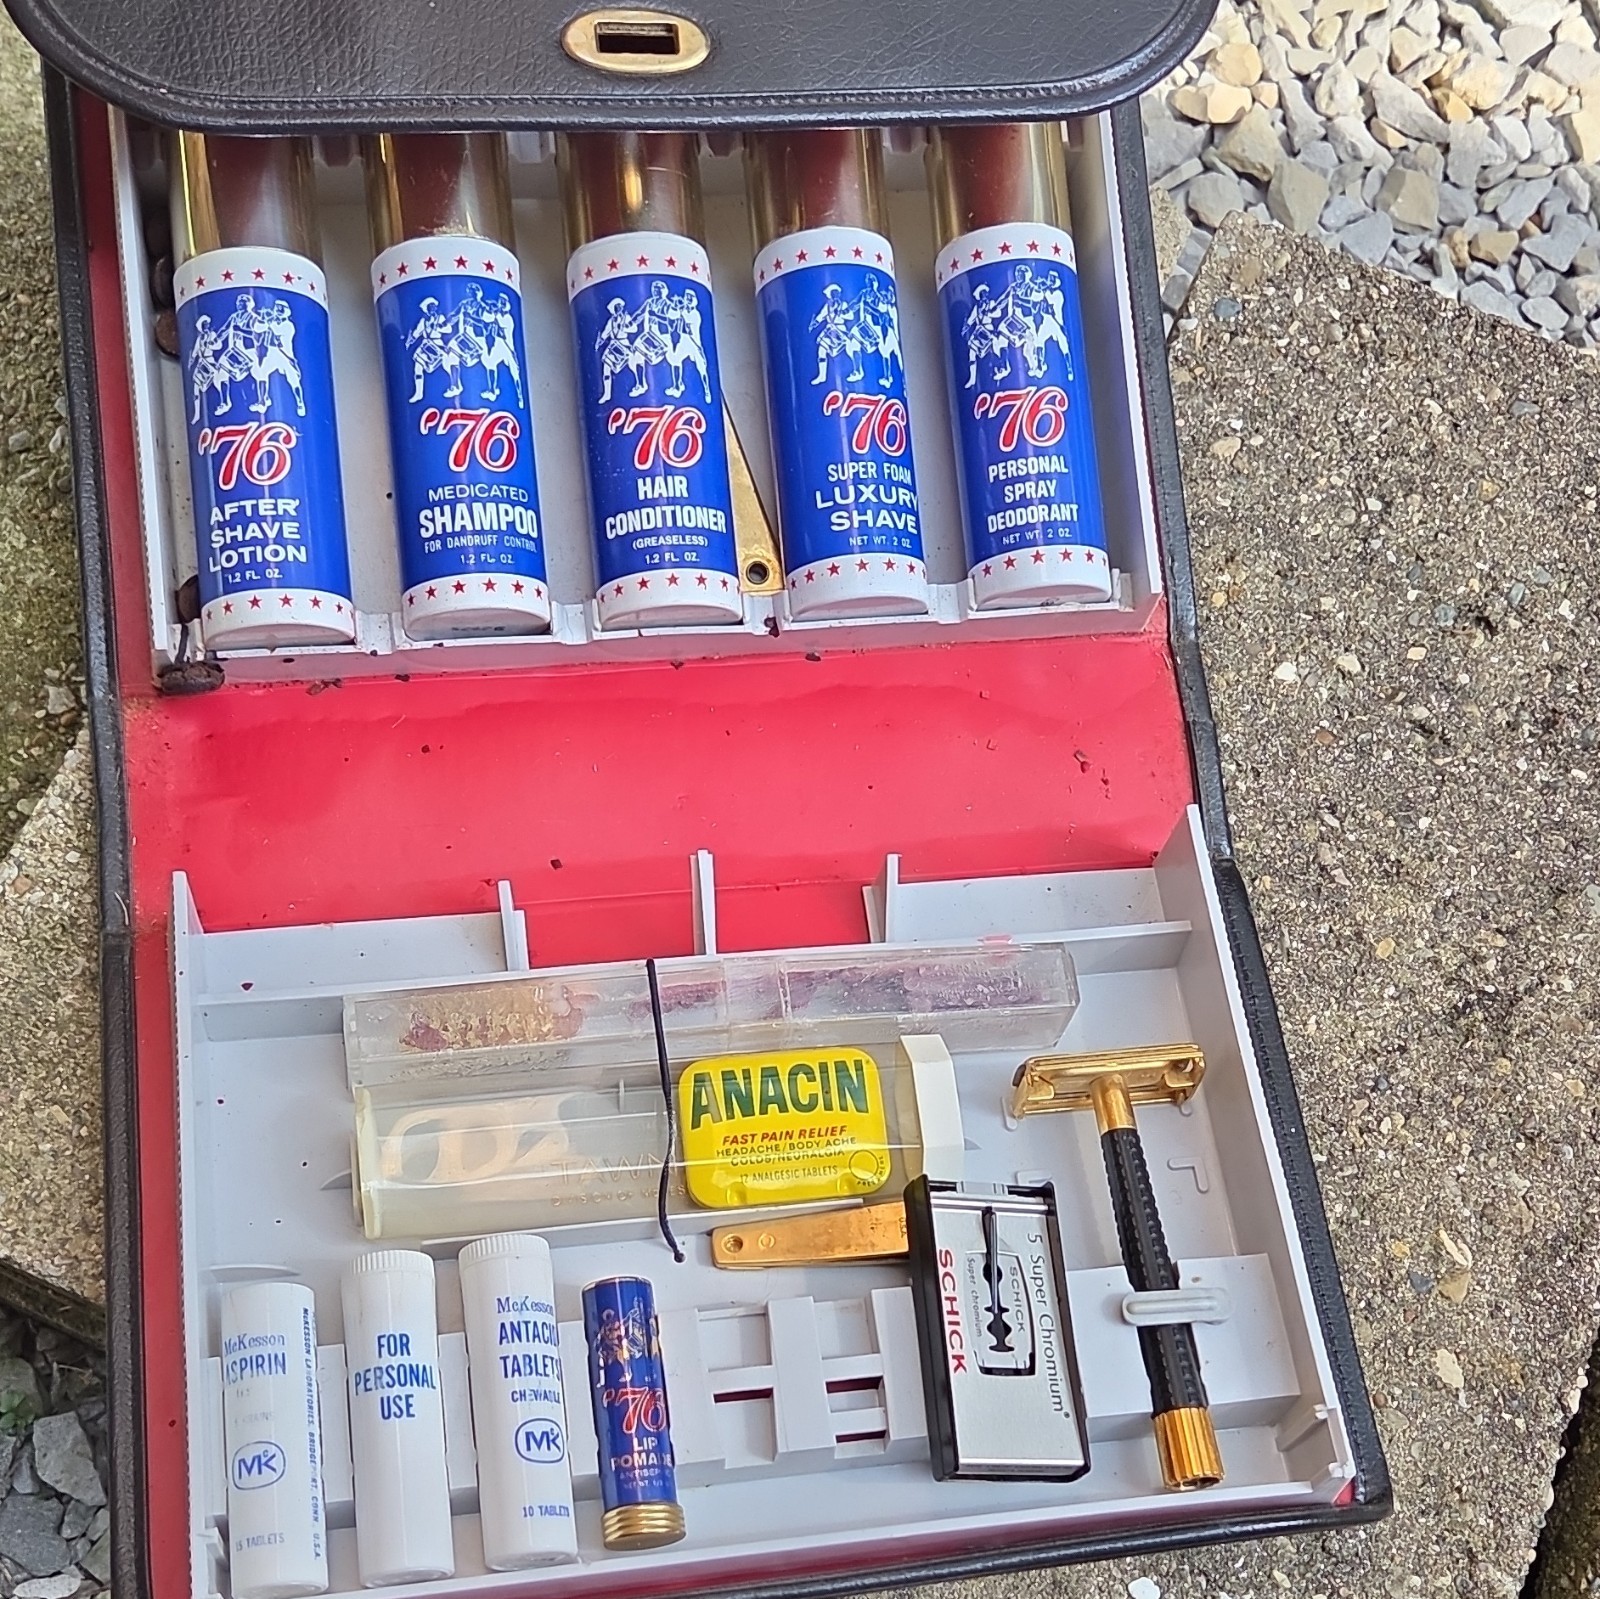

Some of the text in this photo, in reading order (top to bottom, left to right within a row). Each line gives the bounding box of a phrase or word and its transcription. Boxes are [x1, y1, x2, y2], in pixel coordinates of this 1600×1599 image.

[827, 461, 912, 486] SUPER FOAM
[988, 455, 1069, 483] PERSONAL
[428, 484, 528, 503] MEDICATED
[636, 475, 689, 500] HAIR
[815, 484, 918, 511] LUXURY
[1004, 479, 1058, 503] SPRAY
[209, 499, 300, 525] AFTER
[419, 502, 538, 538] SHAMPOO
[605, 505, 727, 539] CONDITIONER
[830, 509, 918, 535] SHAVE
[987, 503, 1079, 533] DEODORANT
[210, 522, 301, 548] SHAVE
[424, 534, 537, 554] FOR DANDRUFF CONTROL
[632, 534, 709, 550] (GREASELESS)
[849, 535, 869, 547] NET
[892, 536, 898, 546] 2
[1002, 532, 1021, 545] NET
[1047, 528, 1054, 538] 2
[208, 545, 307, 573] LOTION
[460, 553, 477, 565] 1.2
[645, 553, 660, 565] 1.2
[227, 572, 242, 584] 1.2
[690, 1059, 870, 1130] ANACIN
[722, 1125, 847, 1146] FAST PAIN RELIEF
[825, 1137, 857, 1147] ACHE
[752, 1169, 800, 1182] ANALGESIC
[802, 1165, 838, 1179] TABLETS
[1027, 1232, 1043, 1244] 5
[1029, 1254, 1048, 1307] Super
[496, 1296, 554, 1316] McKesson
[938, 1248, 968, 1375] SCHICK
[1009, 1266, 1025, 1333] SCHICK
[224, 1333, 285, 1357] McKesson
[377, 1333, 411, 1359] FOR
[499, 1353, 561, 1381] TABLETS
[354, 1364, 437, 1396] PERSONAL
[380, 1394, 416, 1420] USE
[633, 1436, 658, 1452] LIP
[523, 1505, 570, 1518] 10 TABLETS
